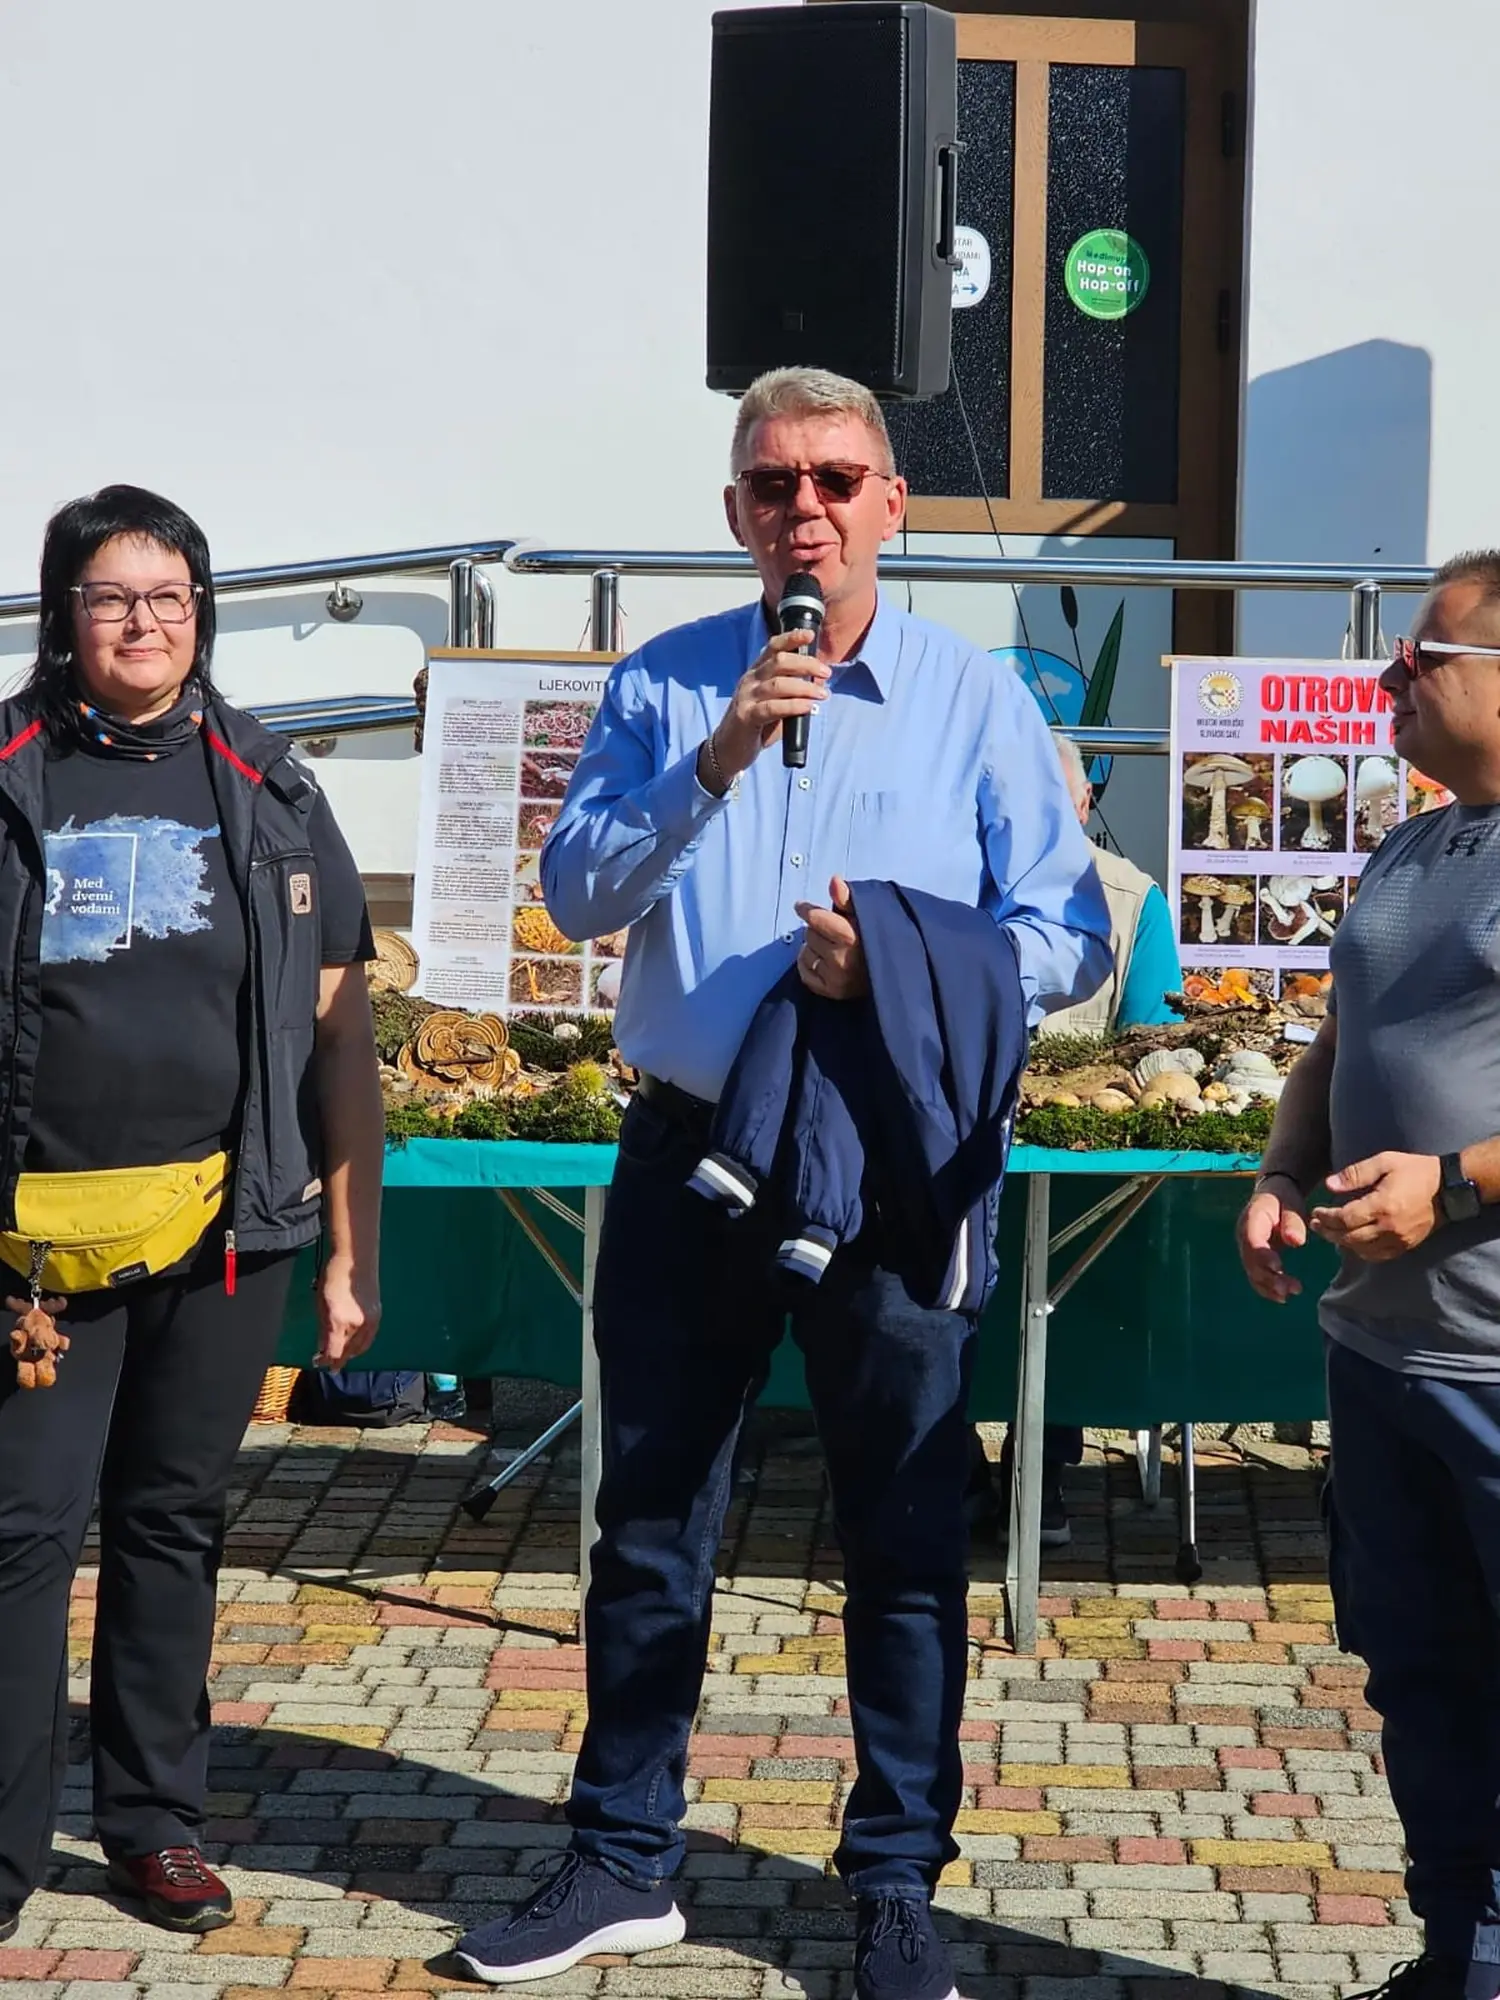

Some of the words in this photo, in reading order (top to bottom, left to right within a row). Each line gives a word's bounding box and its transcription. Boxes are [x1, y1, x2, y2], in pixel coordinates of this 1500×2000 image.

[1077, 260, 1132, 277] Hop-on
[1080, 277, 1139, 294] Hop-off
[539, 679, 603, 692] LJEKOVIT
[1260, 714, 1376, 745] NAŠIH
[74, 876, 104, 889] Med
[72, 890, 114, 901] dvemi
[70, 902, 121, 915] vodami
